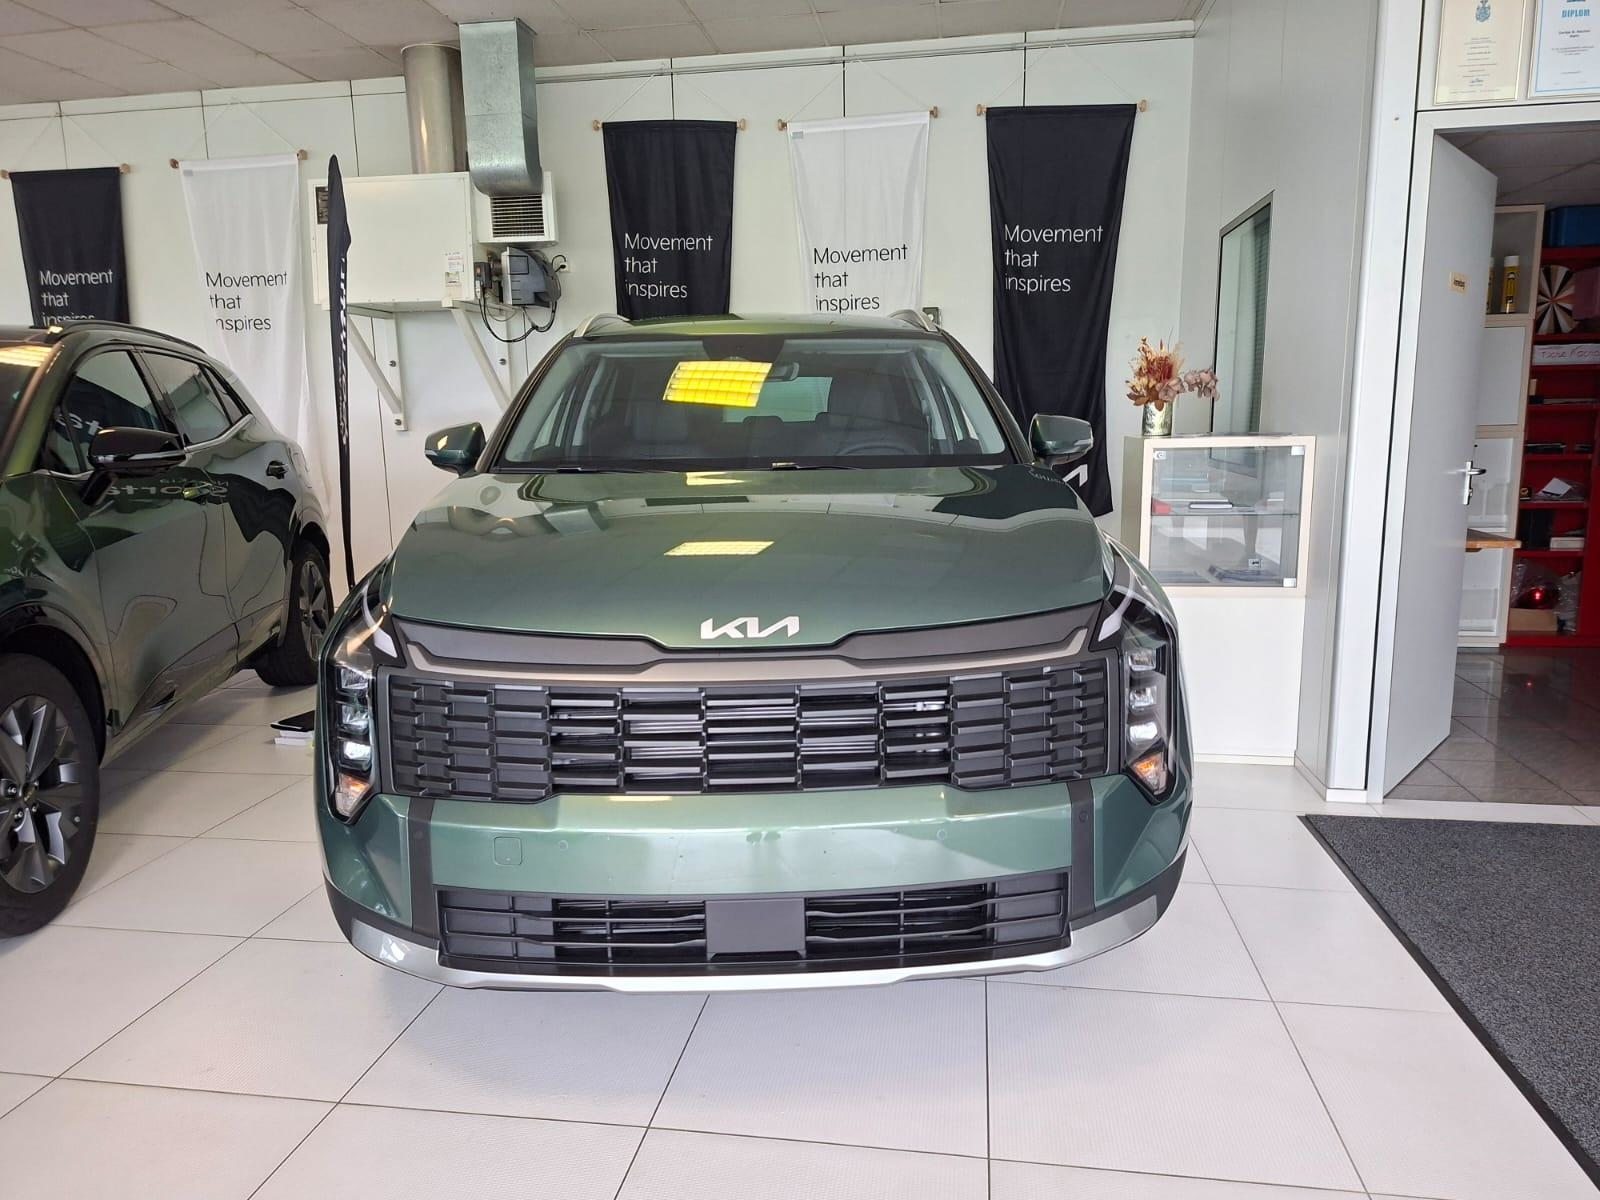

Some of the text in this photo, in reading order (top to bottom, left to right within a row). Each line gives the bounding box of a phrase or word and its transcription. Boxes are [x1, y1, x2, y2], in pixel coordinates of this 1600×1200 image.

[1562, 9, 1590, 17] DIPLOM
[624, 232, 713, 251] Movement
[1004, 224, 1104, 243] Movement
[813, 243, 908, 265] Movement
[1004, 249, 1039, 268] that
[624, 256, 659, 273] that
[40, 269, 113, 286] Movement
[205, 271, 287, 288] Movement
[814, 271, 848, 288] that
[1004, 273, 1071, 295] inspires
[624, 279, 688, 299] inspires
[41, 292, 69, 307] that
[209, 293, 242, 310] that
[815, 294, 880, 314] inspires
[215, 315, 272, 333] nspires
[701, 616, 799, 640] KIA
